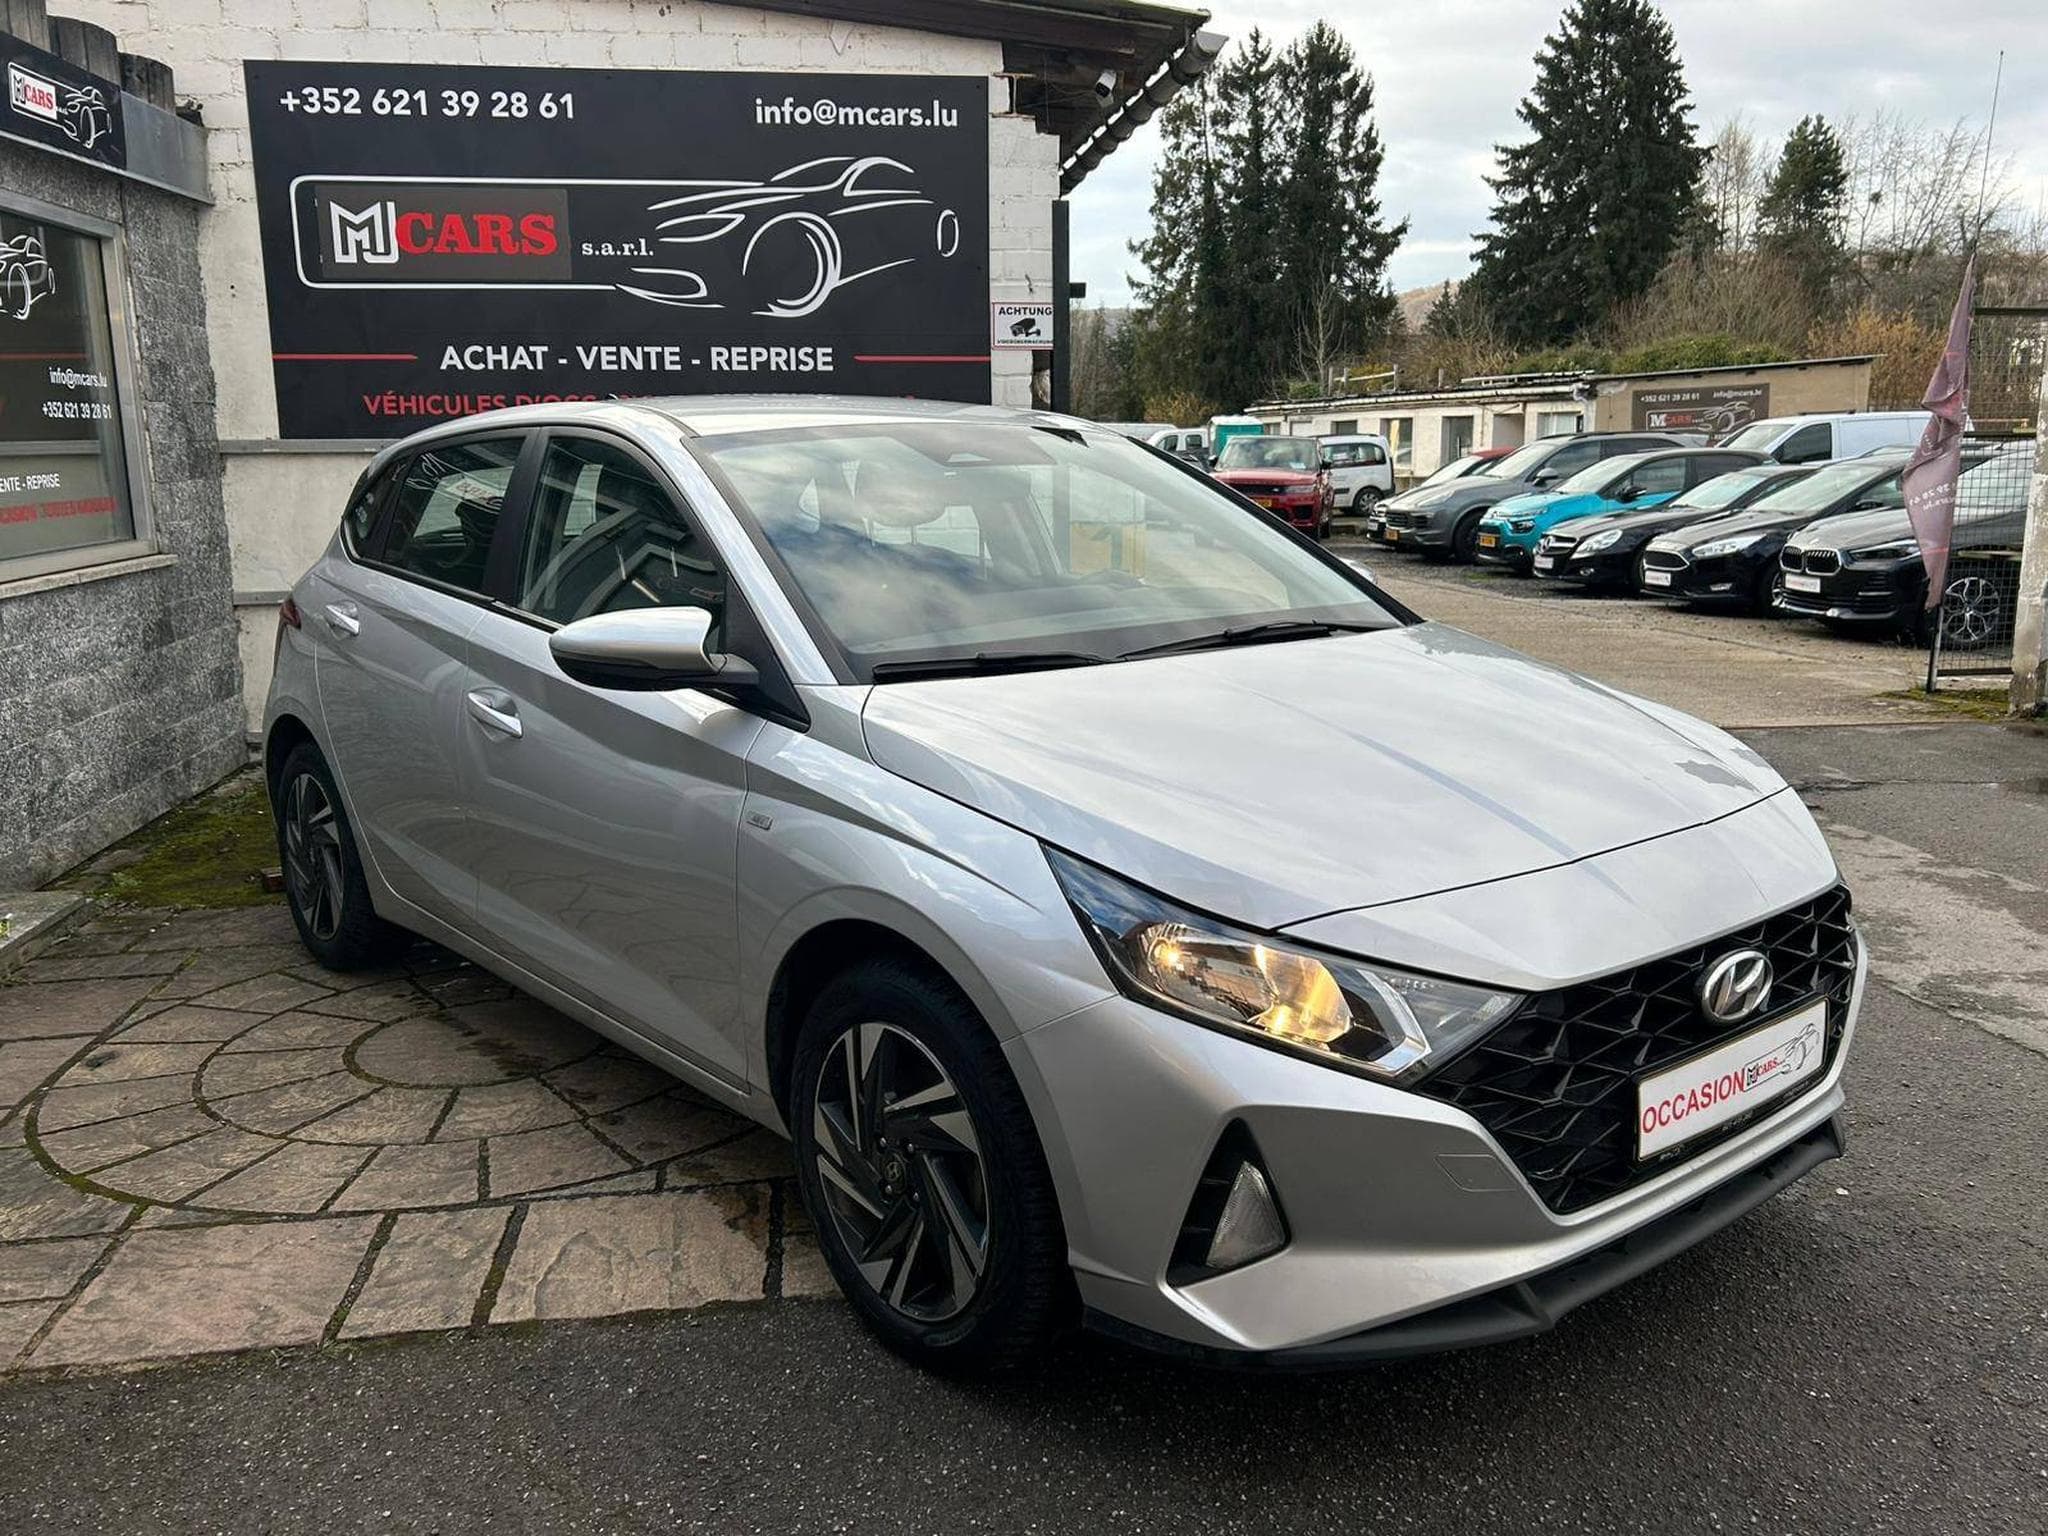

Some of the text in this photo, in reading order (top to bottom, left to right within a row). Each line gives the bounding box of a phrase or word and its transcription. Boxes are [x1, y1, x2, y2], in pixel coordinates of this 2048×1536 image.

[280, 87, 573, 118] +352 621 39 28 61
[755, 97, 958, 126] info@mcars.lu
[582, 239, 653, 256] s.a.r.l.
[999, 307, 1052, 316] ACHTUNG
[440, 346, 548, 370] ACHAT
[576, 347, 681, 370] VENTE
[711, 347, 833, 371] REPRISE
[49, 367, 107, 389] info@mcars.lu
[42, 402, 112, 419] +352 621 39 28 61
[26, 473, 60, 490] REPRISE
[1642, 1067, 1746, 1134] OCCASION
